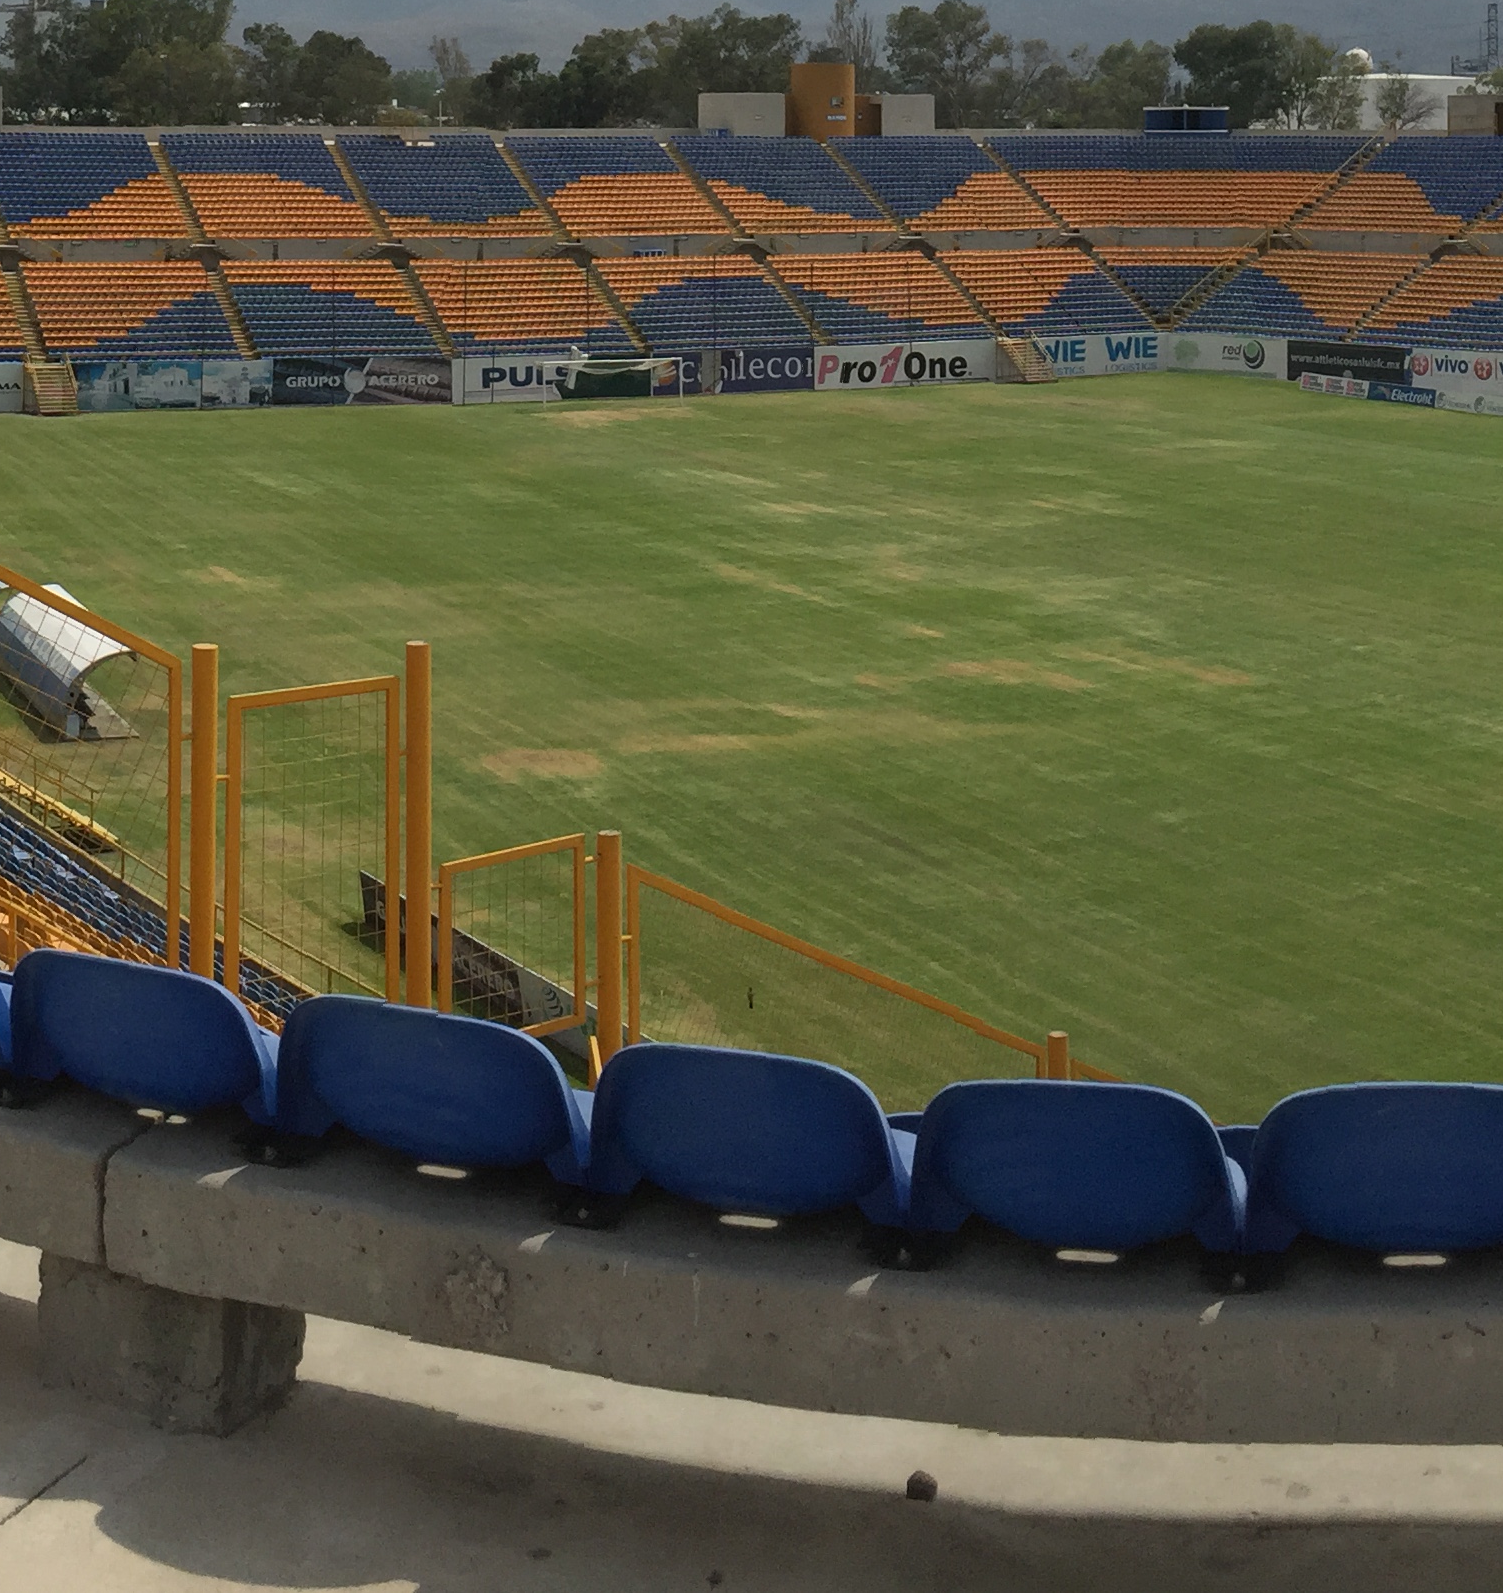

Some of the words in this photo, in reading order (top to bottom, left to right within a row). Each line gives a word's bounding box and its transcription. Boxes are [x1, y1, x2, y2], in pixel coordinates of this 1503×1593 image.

[1105, 336, 1158, 359] WIE
[1222, 344, 1243, 356] red
[1435, 355, 1469, 374] vivo
[285, 375, 341, 388] GRUPO
[368, 373, 440, 387] ACERERO
